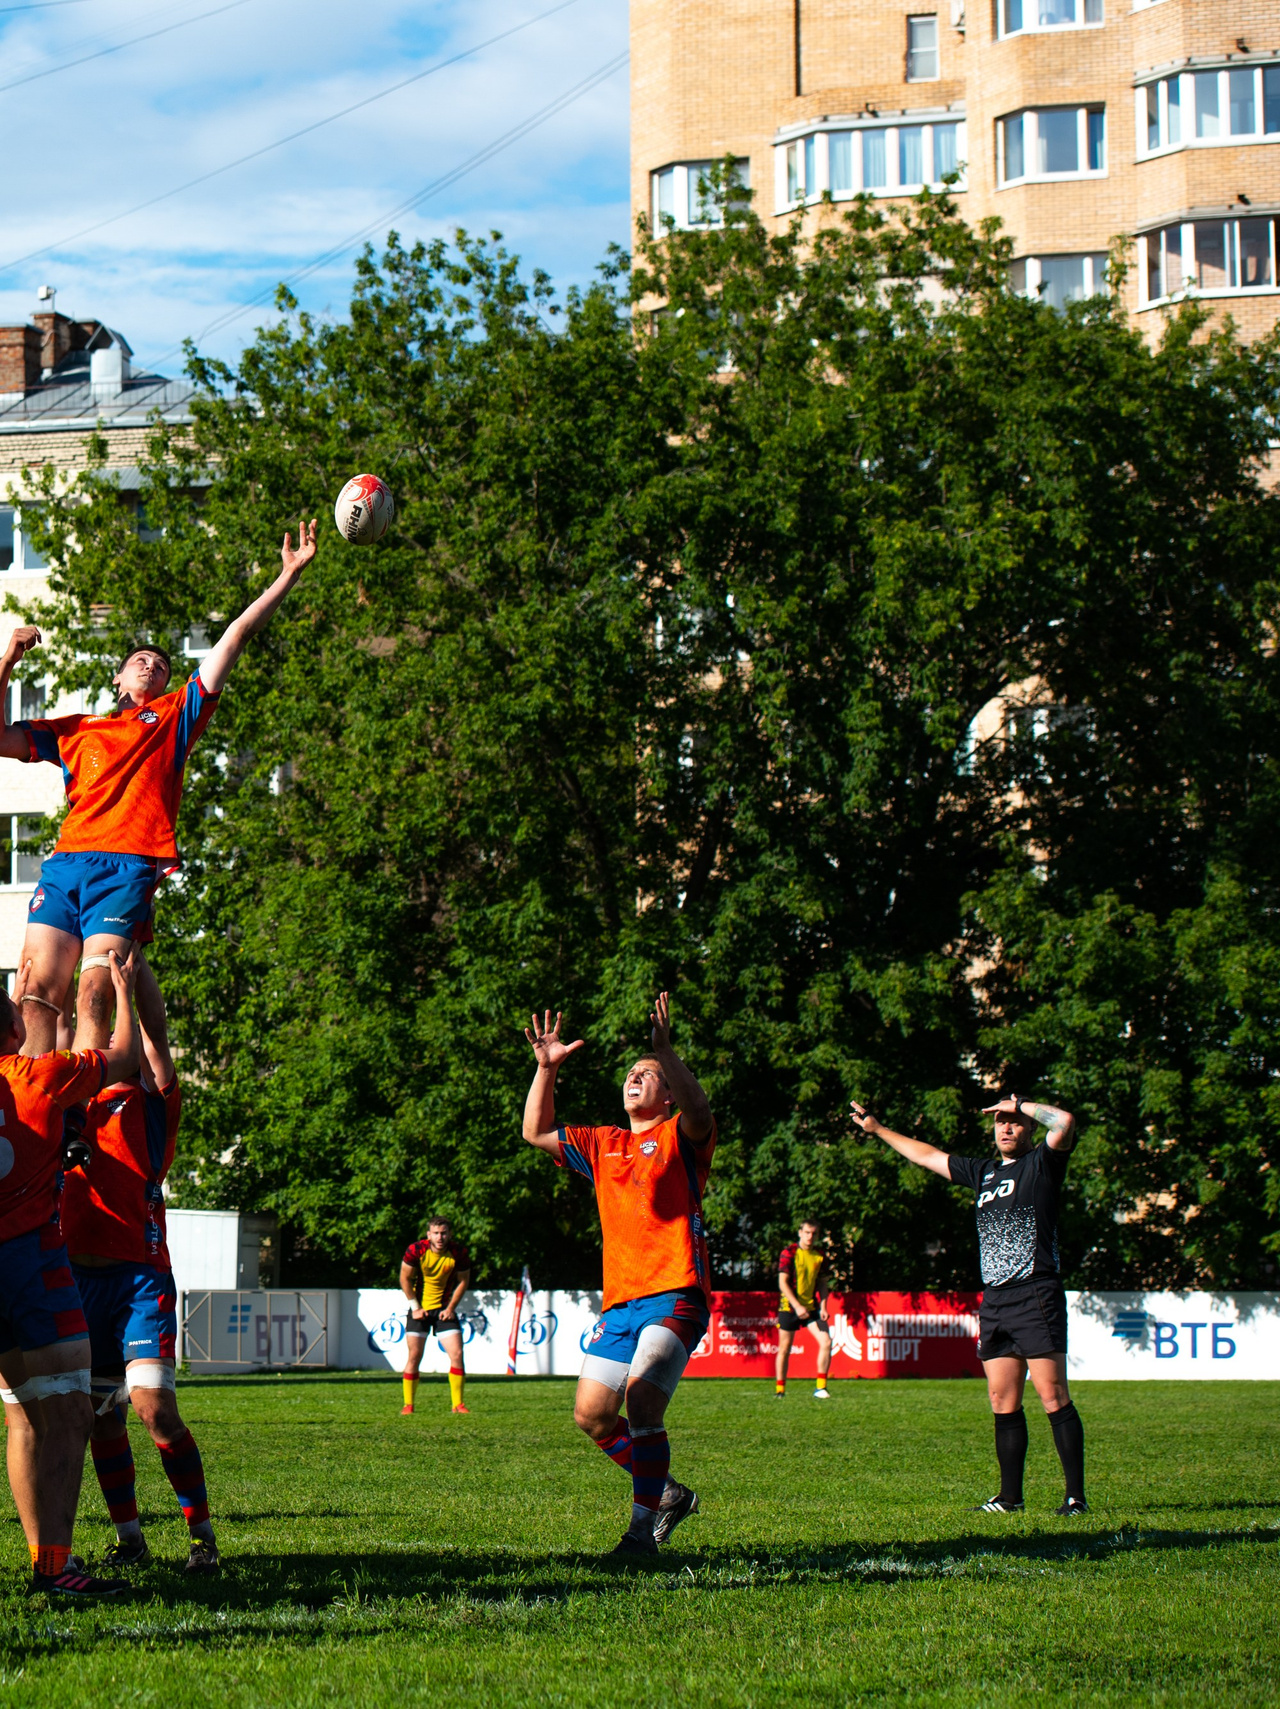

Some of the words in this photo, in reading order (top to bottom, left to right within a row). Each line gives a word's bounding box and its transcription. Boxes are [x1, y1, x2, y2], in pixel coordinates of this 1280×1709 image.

[255, 1315, 308, 1357] ВТБ
[719, 1330, 758, 1342] спорта
[867, 1310, 981, 1338] МОСКОВСКИЙ
[719, 1344, 758, 1356] города
[867, 1338, 921, 1361] СПОРТ
[1155, 1322, 1236, 1359] ВТБ
